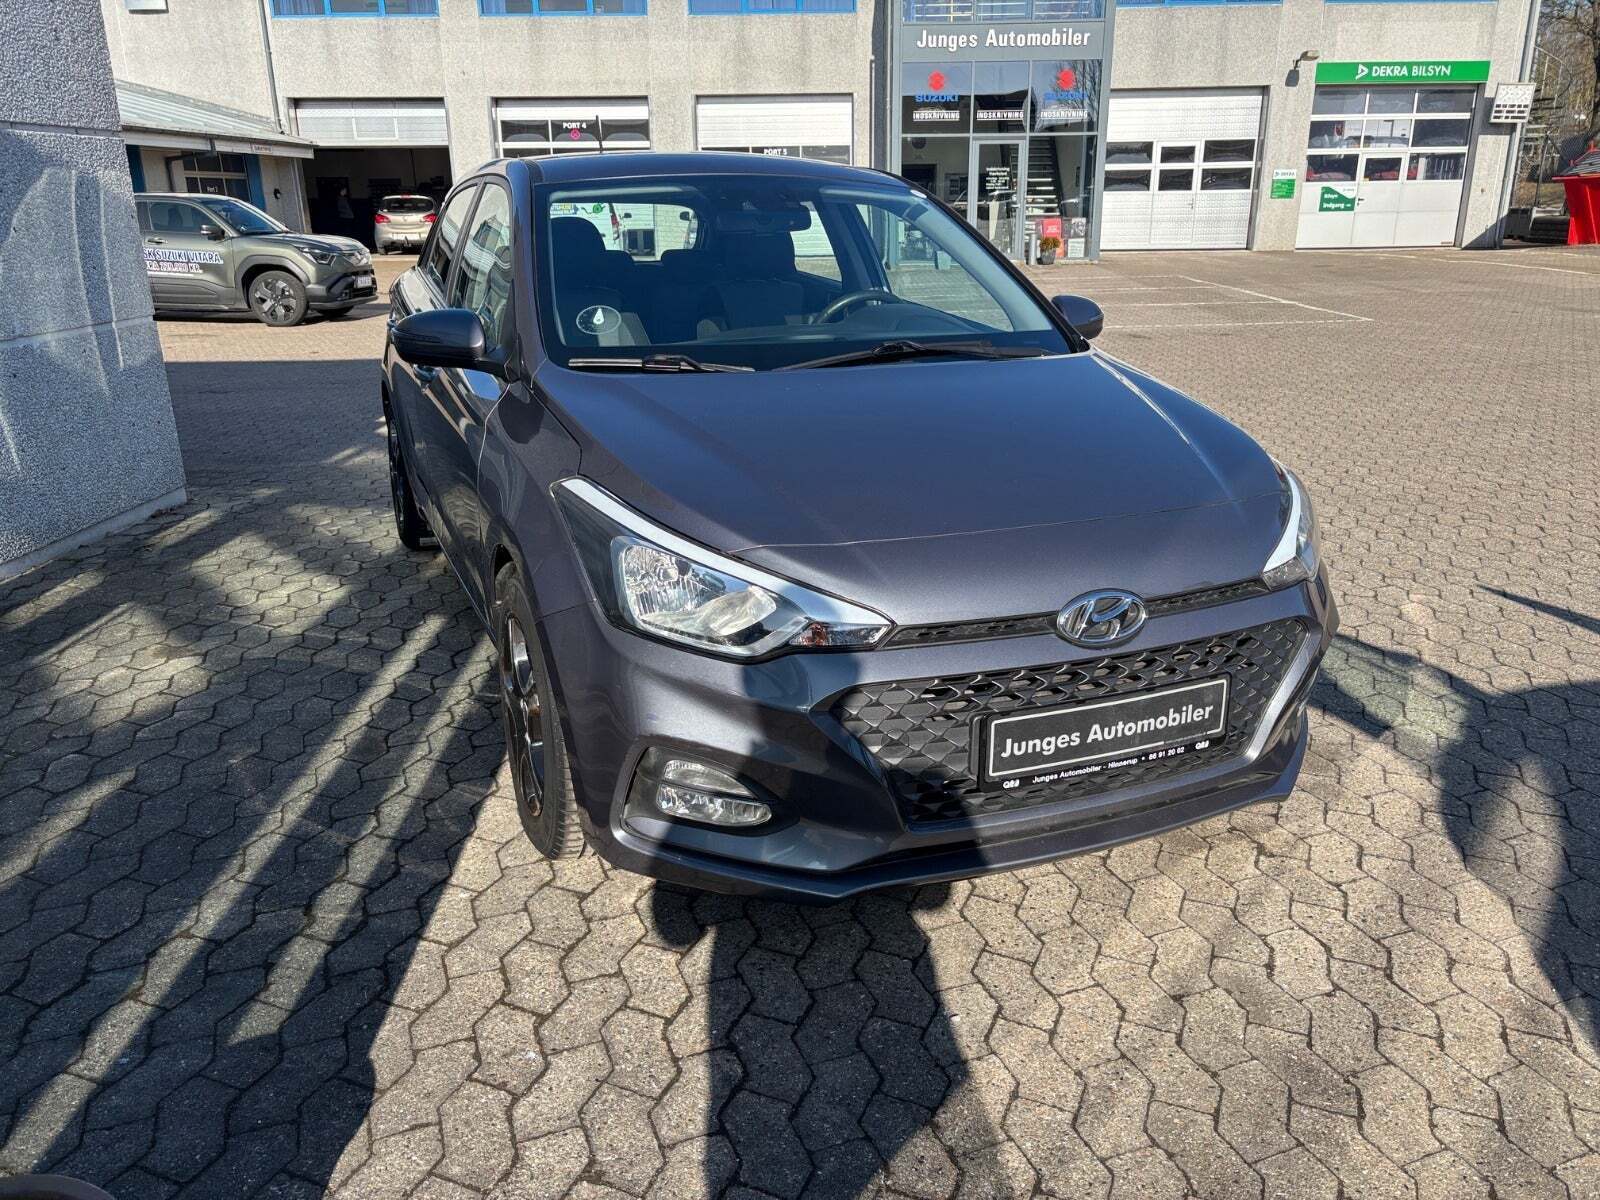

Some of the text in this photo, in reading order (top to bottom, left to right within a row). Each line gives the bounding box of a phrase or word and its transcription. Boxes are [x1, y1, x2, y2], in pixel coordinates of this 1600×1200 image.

[917, 28, 1091, 51] Junges Automobiler
[1372, 64, 1452, 77] DEKRA BILSYN
[915, 92, 960, 103] SUZUKI
[912, 111, 960, 121] INDSKRIVNING
[976, 110, 1024, 120] INDSKRIVNING
[1040, 110, 1088, 119] INDSKRIVNING
[155, 249, 187, 262] SUZUKI
[1001, 704, 1213, 757] Junges Automobiler
[1032, 773, 1058, 784] Junges
[1059, 764, 1102, 779] Automobiler
[1108, 757, 1138, 769] Hinnerup
